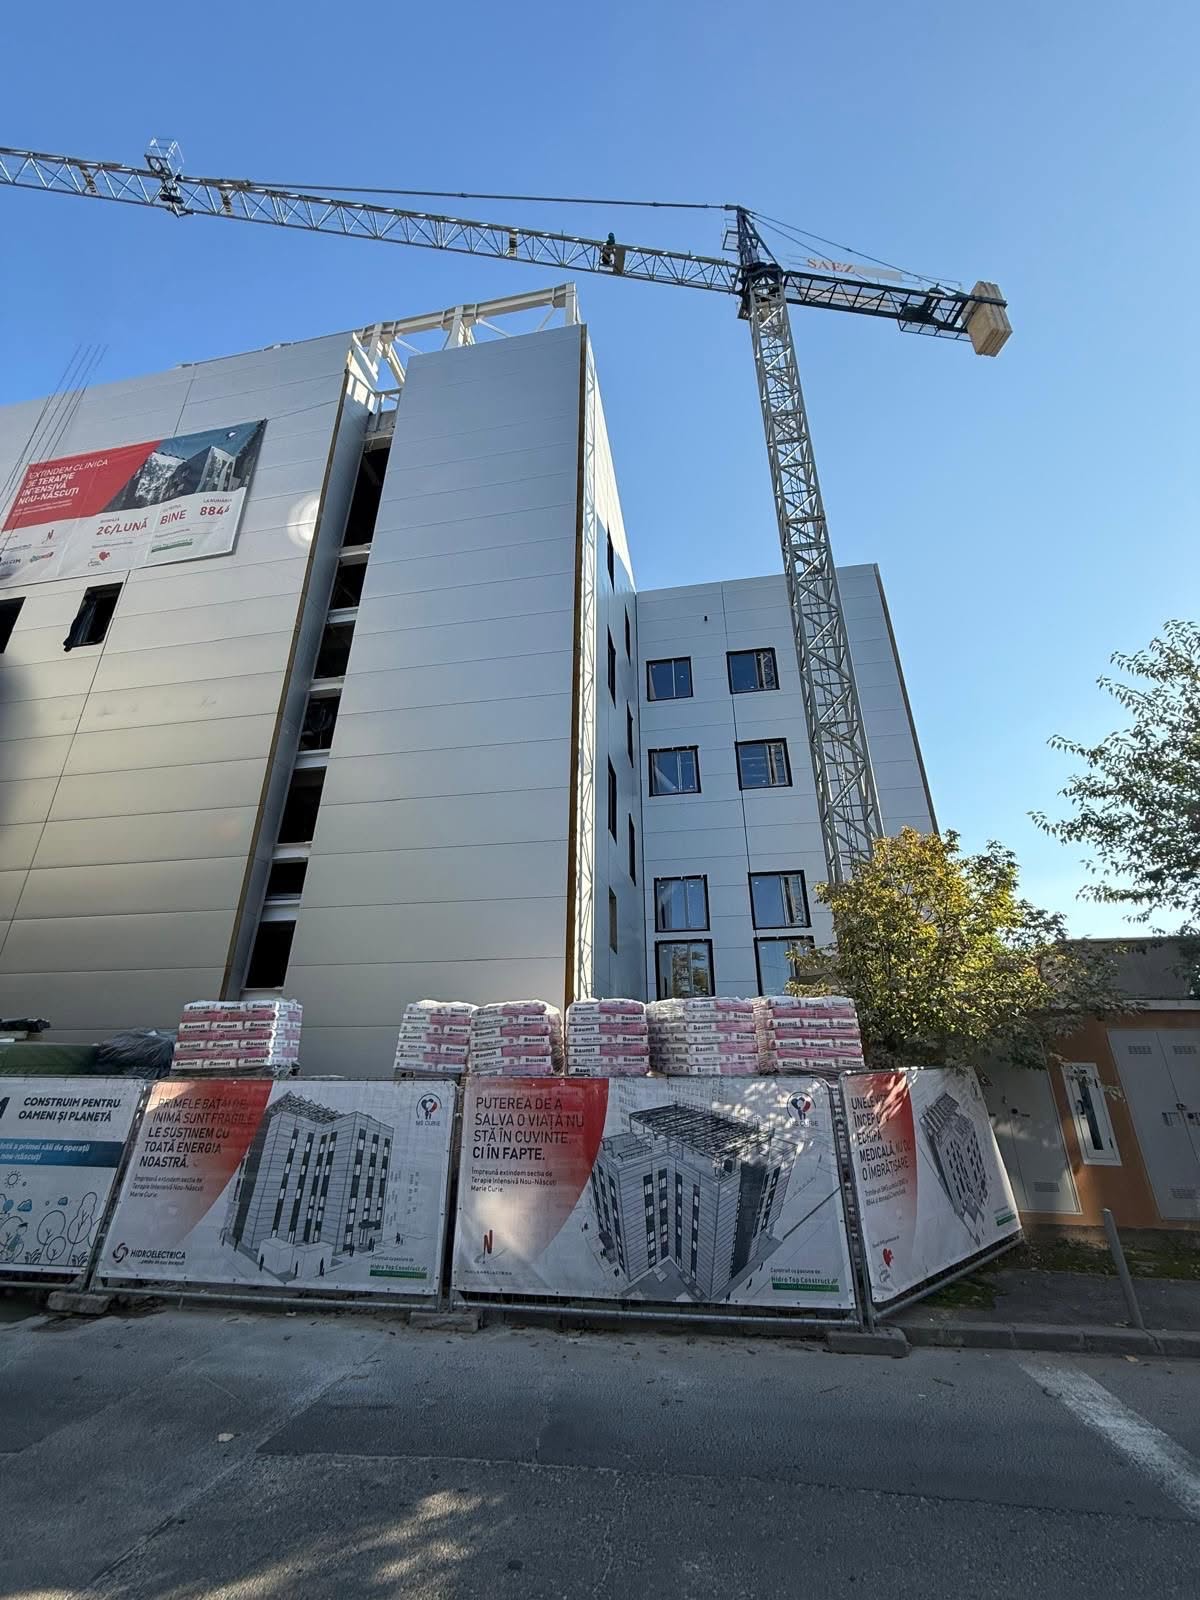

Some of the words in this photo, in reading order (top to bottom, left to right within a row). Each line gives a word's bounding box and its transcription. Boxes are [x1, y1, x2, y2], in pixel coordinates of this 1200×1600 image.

[807, 257, 855, 273] SAEZ
[29, 465, 73, 479] EXTINDEM
[38, 472, 75, 485] TERAPIE
[160, 509, 187, 525] BINE
[23, 1097, 81, 1107] CONSTRUIM
[81, 1098, 121, 1108] PENTRU
[160, 1098, 199, 1109] PRIMELE
[476, 1096, 532, 1110] PUTEREA
[535, 1097, 552, 1110] DE
[554, 1098, 563, 1110] A
[18, 1110, 57, 1120] OAMENI
[57, 1111, 67, 1124] ȘI
[68, 1110, 113, 1122] PLANETĂ
[153, 1110, 180, 1124] INIMĂ
[182, 1112, 212, 1124] SUNT
[475, 1112, 515, 1127] SALVA
[517, 1113, 525, 1127] O
[566, 1115, 585, 1127] NU
[148, 1127, 162, 1138] LE
[162, 1127, 214, 1141] SUSȚINEM
[216, 1127, 230, 1139] CU
[473, 1127, 497, 1143] STĂ
[499, 1127, 512, 1143] ÎN
[514, 1130, 572, 1145] CUVINTE.
[54, 1143, 63, 1151] de
[144, 1138, 174, 1153] TOATĂ
[176, 1141, 222, 1153] ENERGIA
[472, 1146, 484, 1159] CI
[486, 1143, 500, 1160] ÎN
[502, 1147, 545, 1161] FAPTE.
[139, 1153, 189, 1168] NOASTRĂ.
[471, 1166, 499, 1176] Împreună
[862, 1167, 868, 1181] O
[471, 1176, 492, 1184] Terapie
[492, 1177, 519, 1185] Intensivă
[130, 1249, 186, 1260] HIDROELECTRICA
